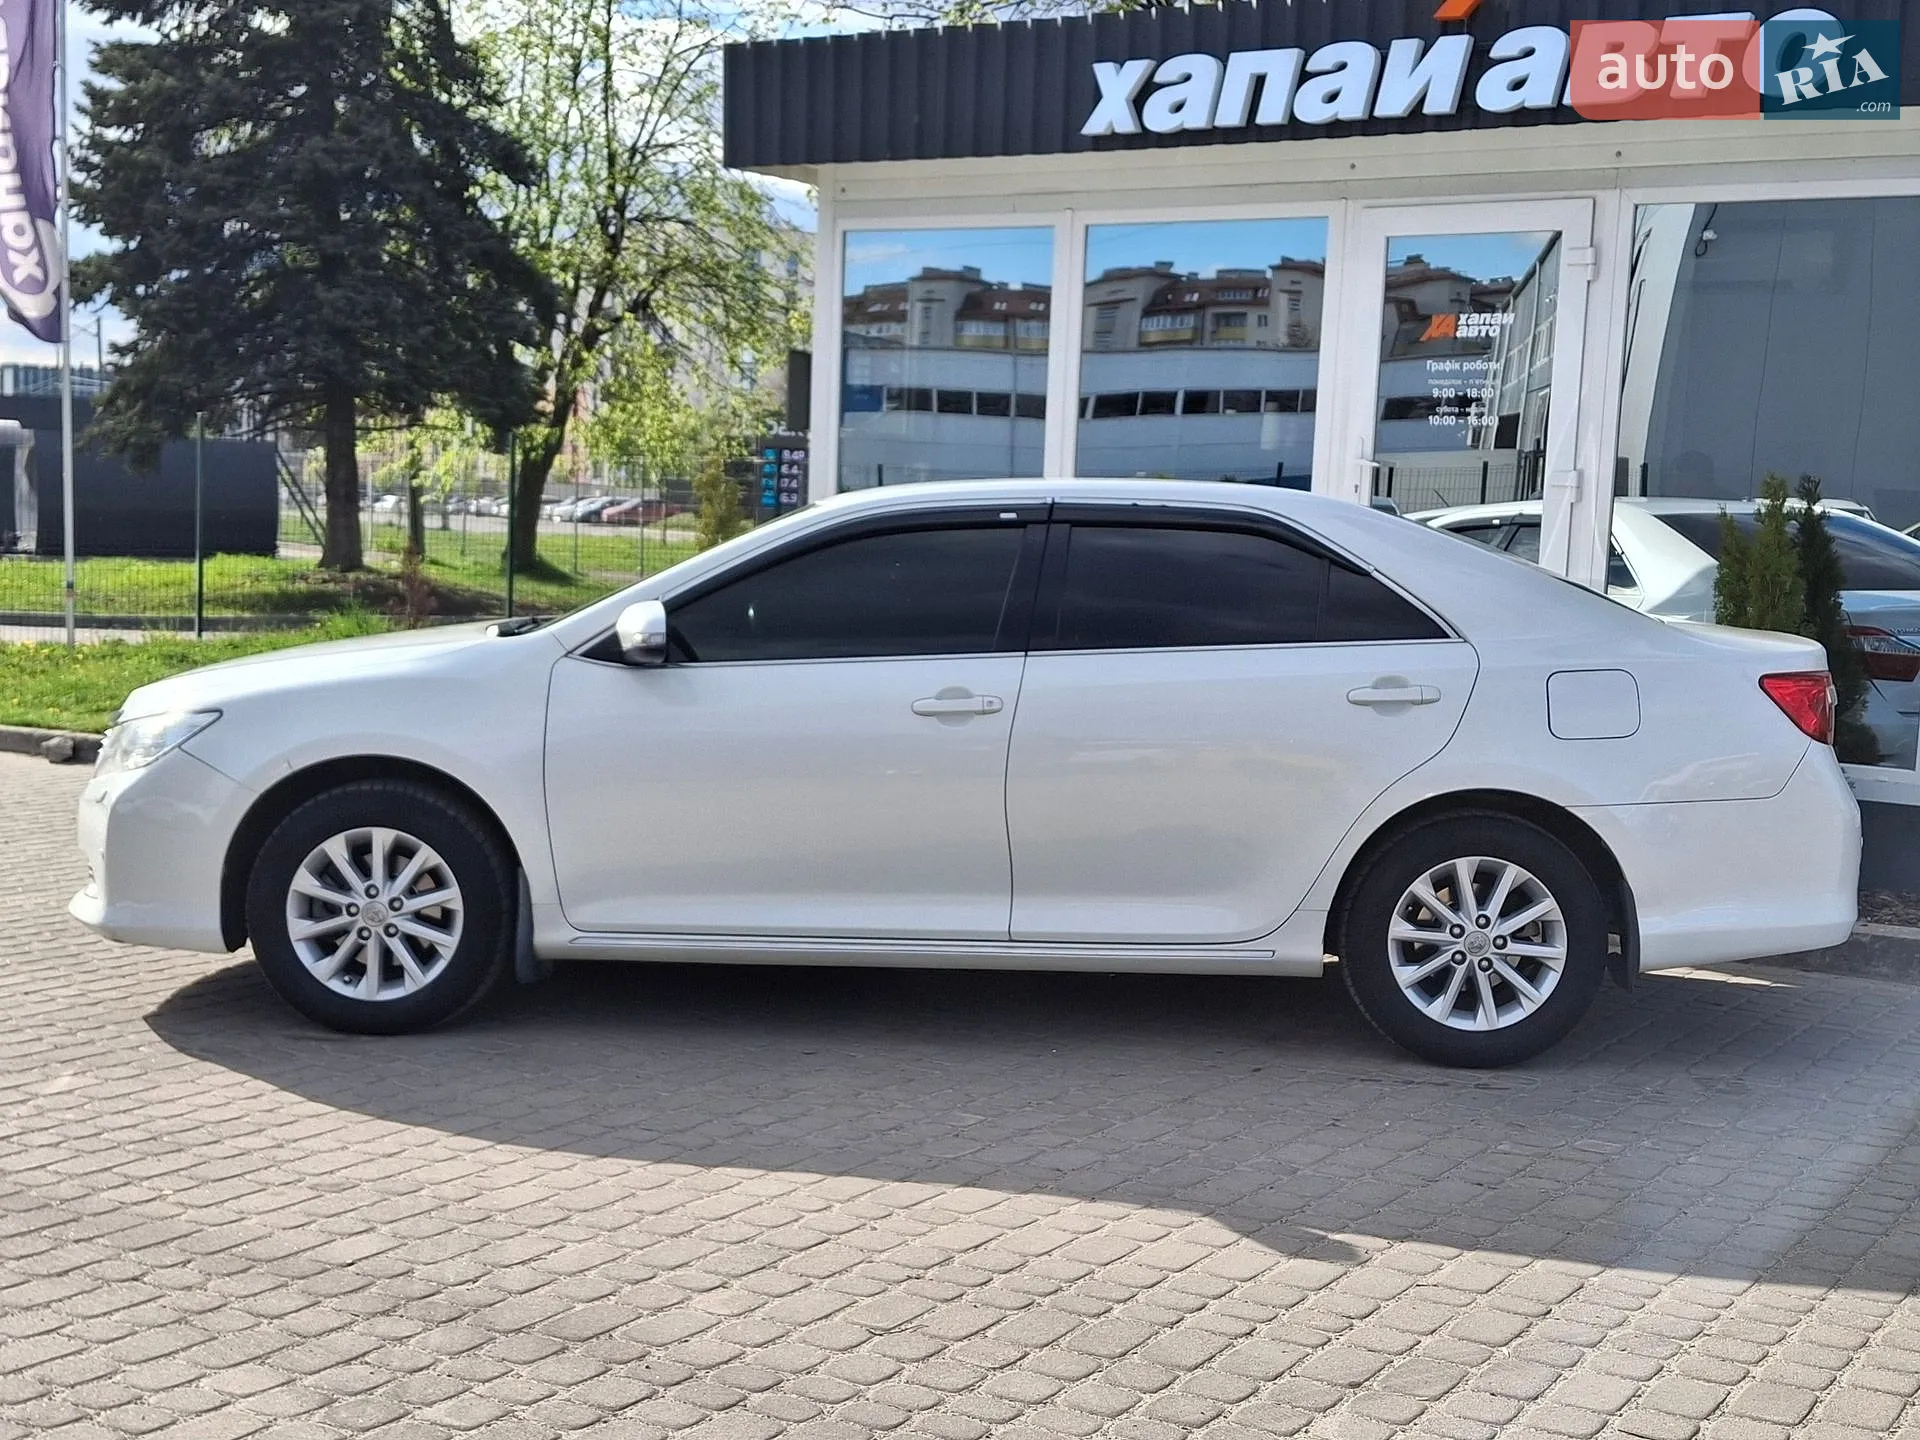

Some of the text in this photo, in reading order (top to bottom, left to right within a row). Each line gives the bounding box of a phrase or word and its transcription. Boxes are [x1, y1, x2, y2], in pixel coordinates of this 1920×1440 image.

[1455, 325, 1501, 338] авто
[1426, 360, 1461, 373] Графік
[1432, 387, 1455, 398] 9:00
[1466, 387, 1494, 398] 18:00
[1428, 415, 1456, 426] 10:00
